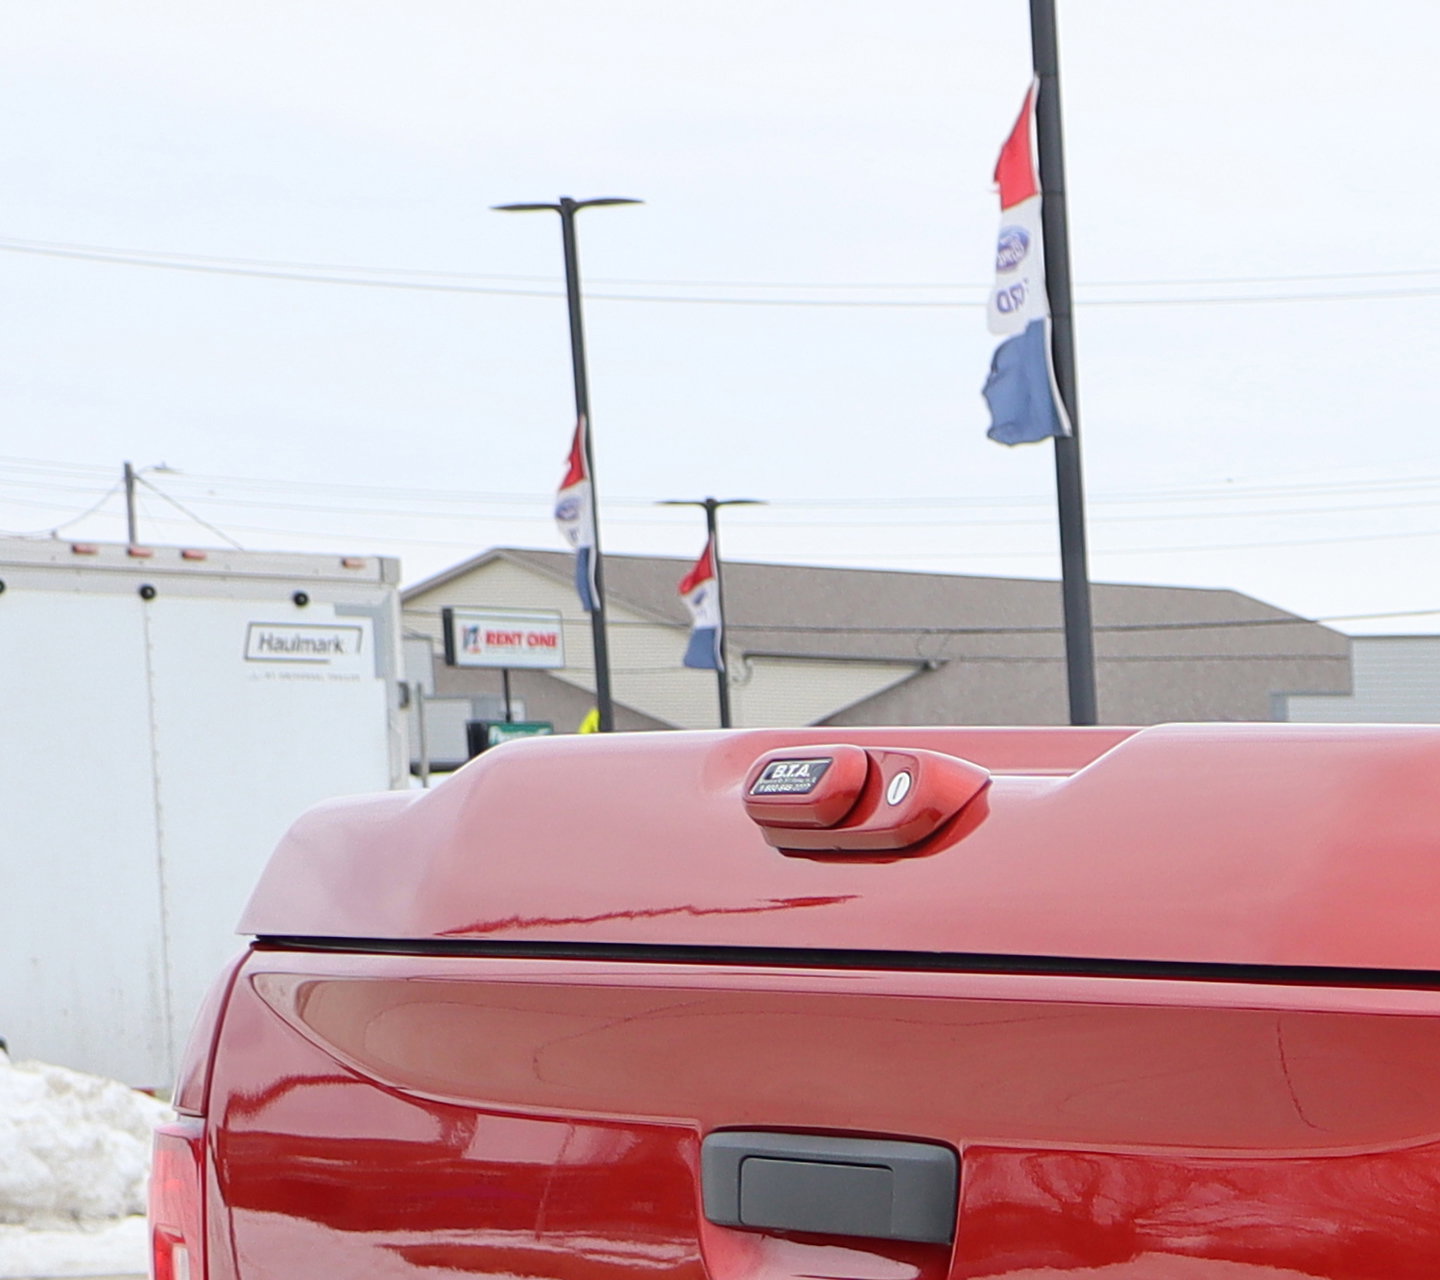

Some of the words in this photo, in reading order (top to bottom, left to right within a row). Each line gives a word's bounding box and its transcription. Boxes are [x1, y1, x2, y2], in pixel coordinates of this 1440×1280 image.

[259, 633, 344, 654] Haulmark
[486, 631, 523, 646] RENT
[527, 633, 558, 648] ONE
